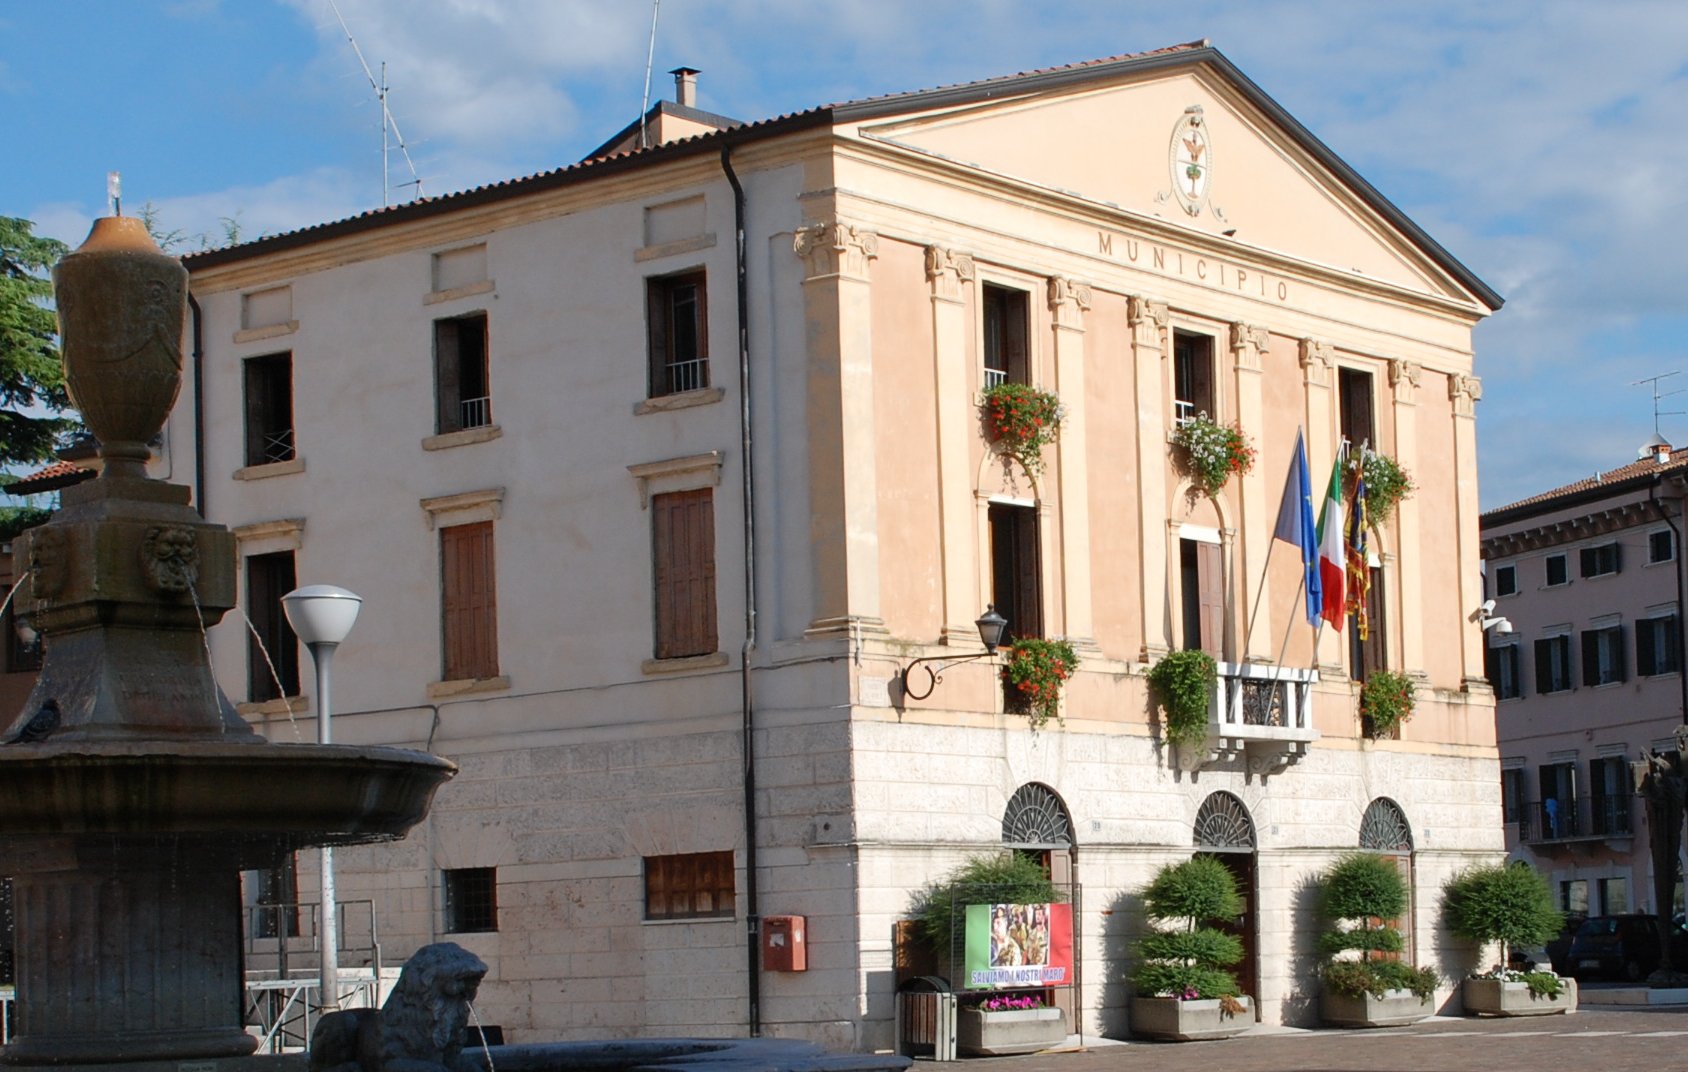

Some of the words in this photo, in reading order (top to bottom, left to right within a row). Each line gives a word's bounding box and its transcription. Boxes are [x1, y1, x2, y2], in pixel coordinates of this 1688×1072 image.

[1098, 231, 1287, 301] MUNICIPIO
[972, 970, 1009, 984] SALVIAMO
[1016, 969, 1041, 982] NOSTRI
